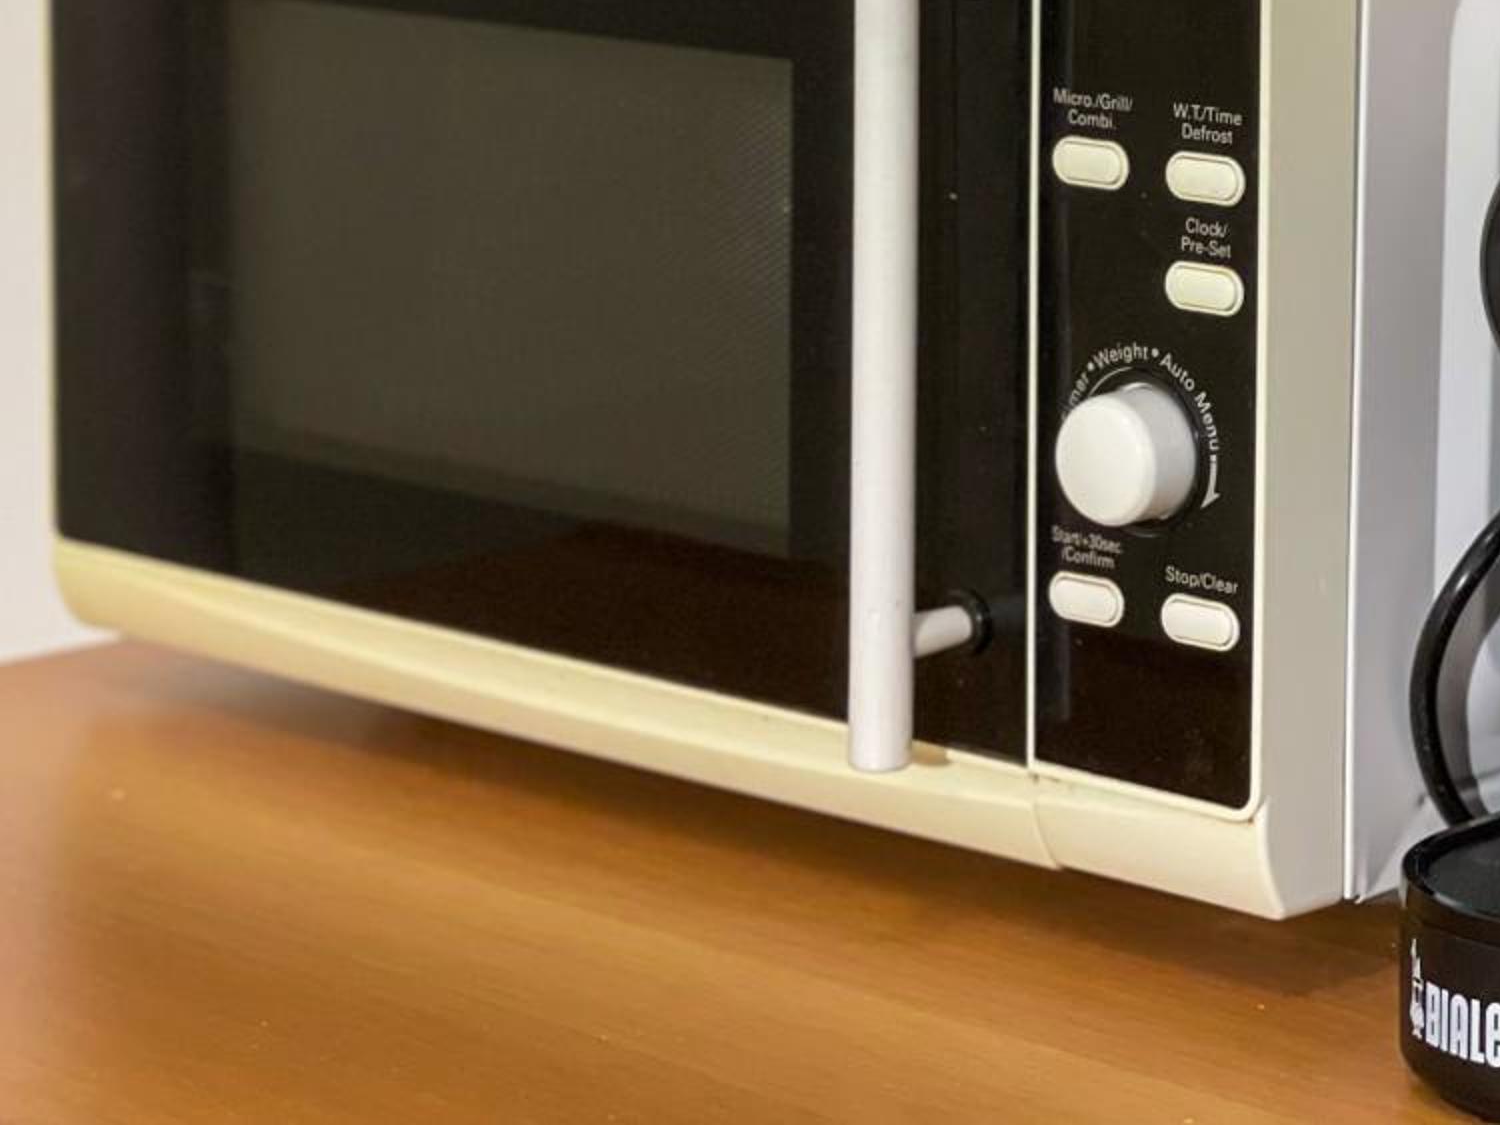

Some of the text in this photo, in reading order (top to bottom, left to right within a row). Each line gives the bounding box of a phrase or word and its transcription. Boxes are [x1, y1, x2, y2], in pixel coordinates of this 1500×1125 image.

[1181, 123, 1234, 145] Defrost
[1180, 236, 1232, 259] Pre-Set
[1093, 342, 1149, 368] Weight
[1159, 352, 1196, 392] Auto
[1194, 391, 1221, 452] Menu
[1164, 565, 1239, 594] Stop/Clear
